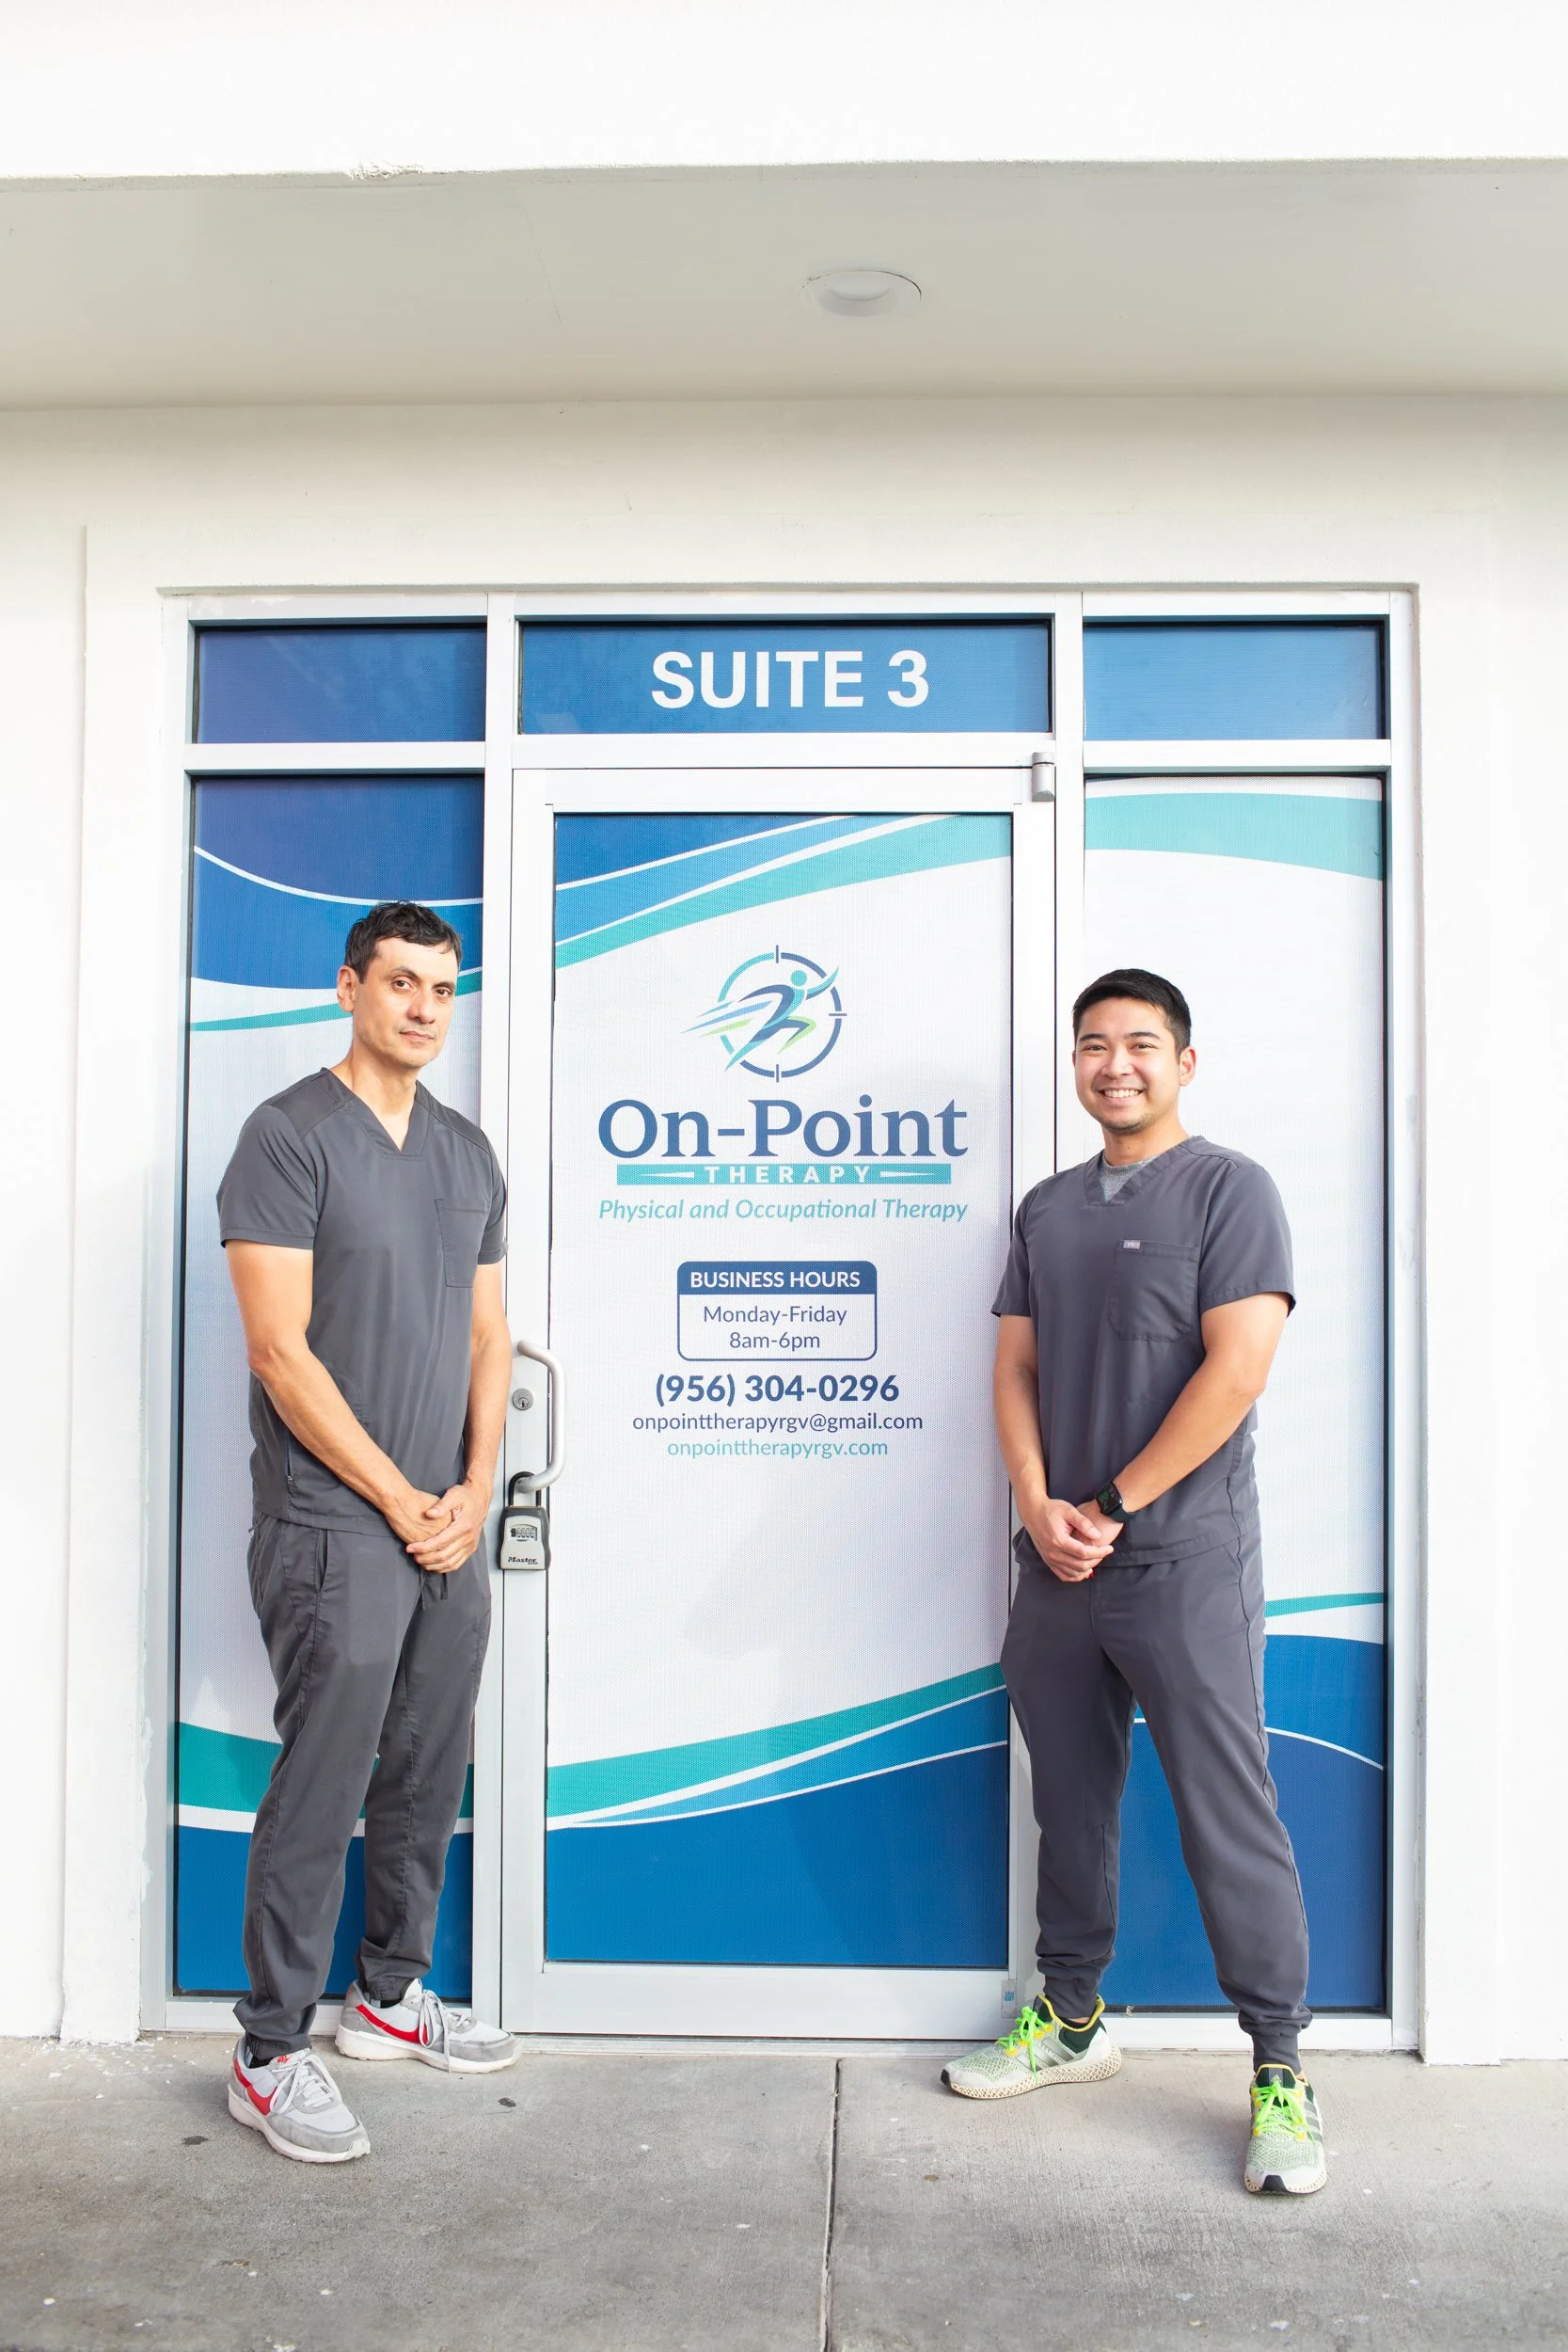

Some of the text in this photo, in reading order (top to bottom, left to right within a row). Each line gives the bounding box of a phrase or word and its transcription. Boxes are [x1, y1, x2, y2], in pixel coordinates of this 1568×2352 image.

[651, 649, 929, 708] SUITE 3
[598, 1094, 969, 1158] On-Point
[704, 1165, 871, 1184] THERAPY
[598, 1199, 969, 1223] Physical and Occupational Therapy
[689, 1271, 861, 1288] BUSINESS HOURS
[704, 1305, 847, 1327] Monday-Friday
[729, 1331, 821, 1352] 8am-6pm
[656, 1374, 900, 1407] (956) 304-0296
[632, 1412, 924, 1434] onpointtherapyrgv@gmail.com
[667, 1438, 889, 1459] onpointtherapyrgv.com
